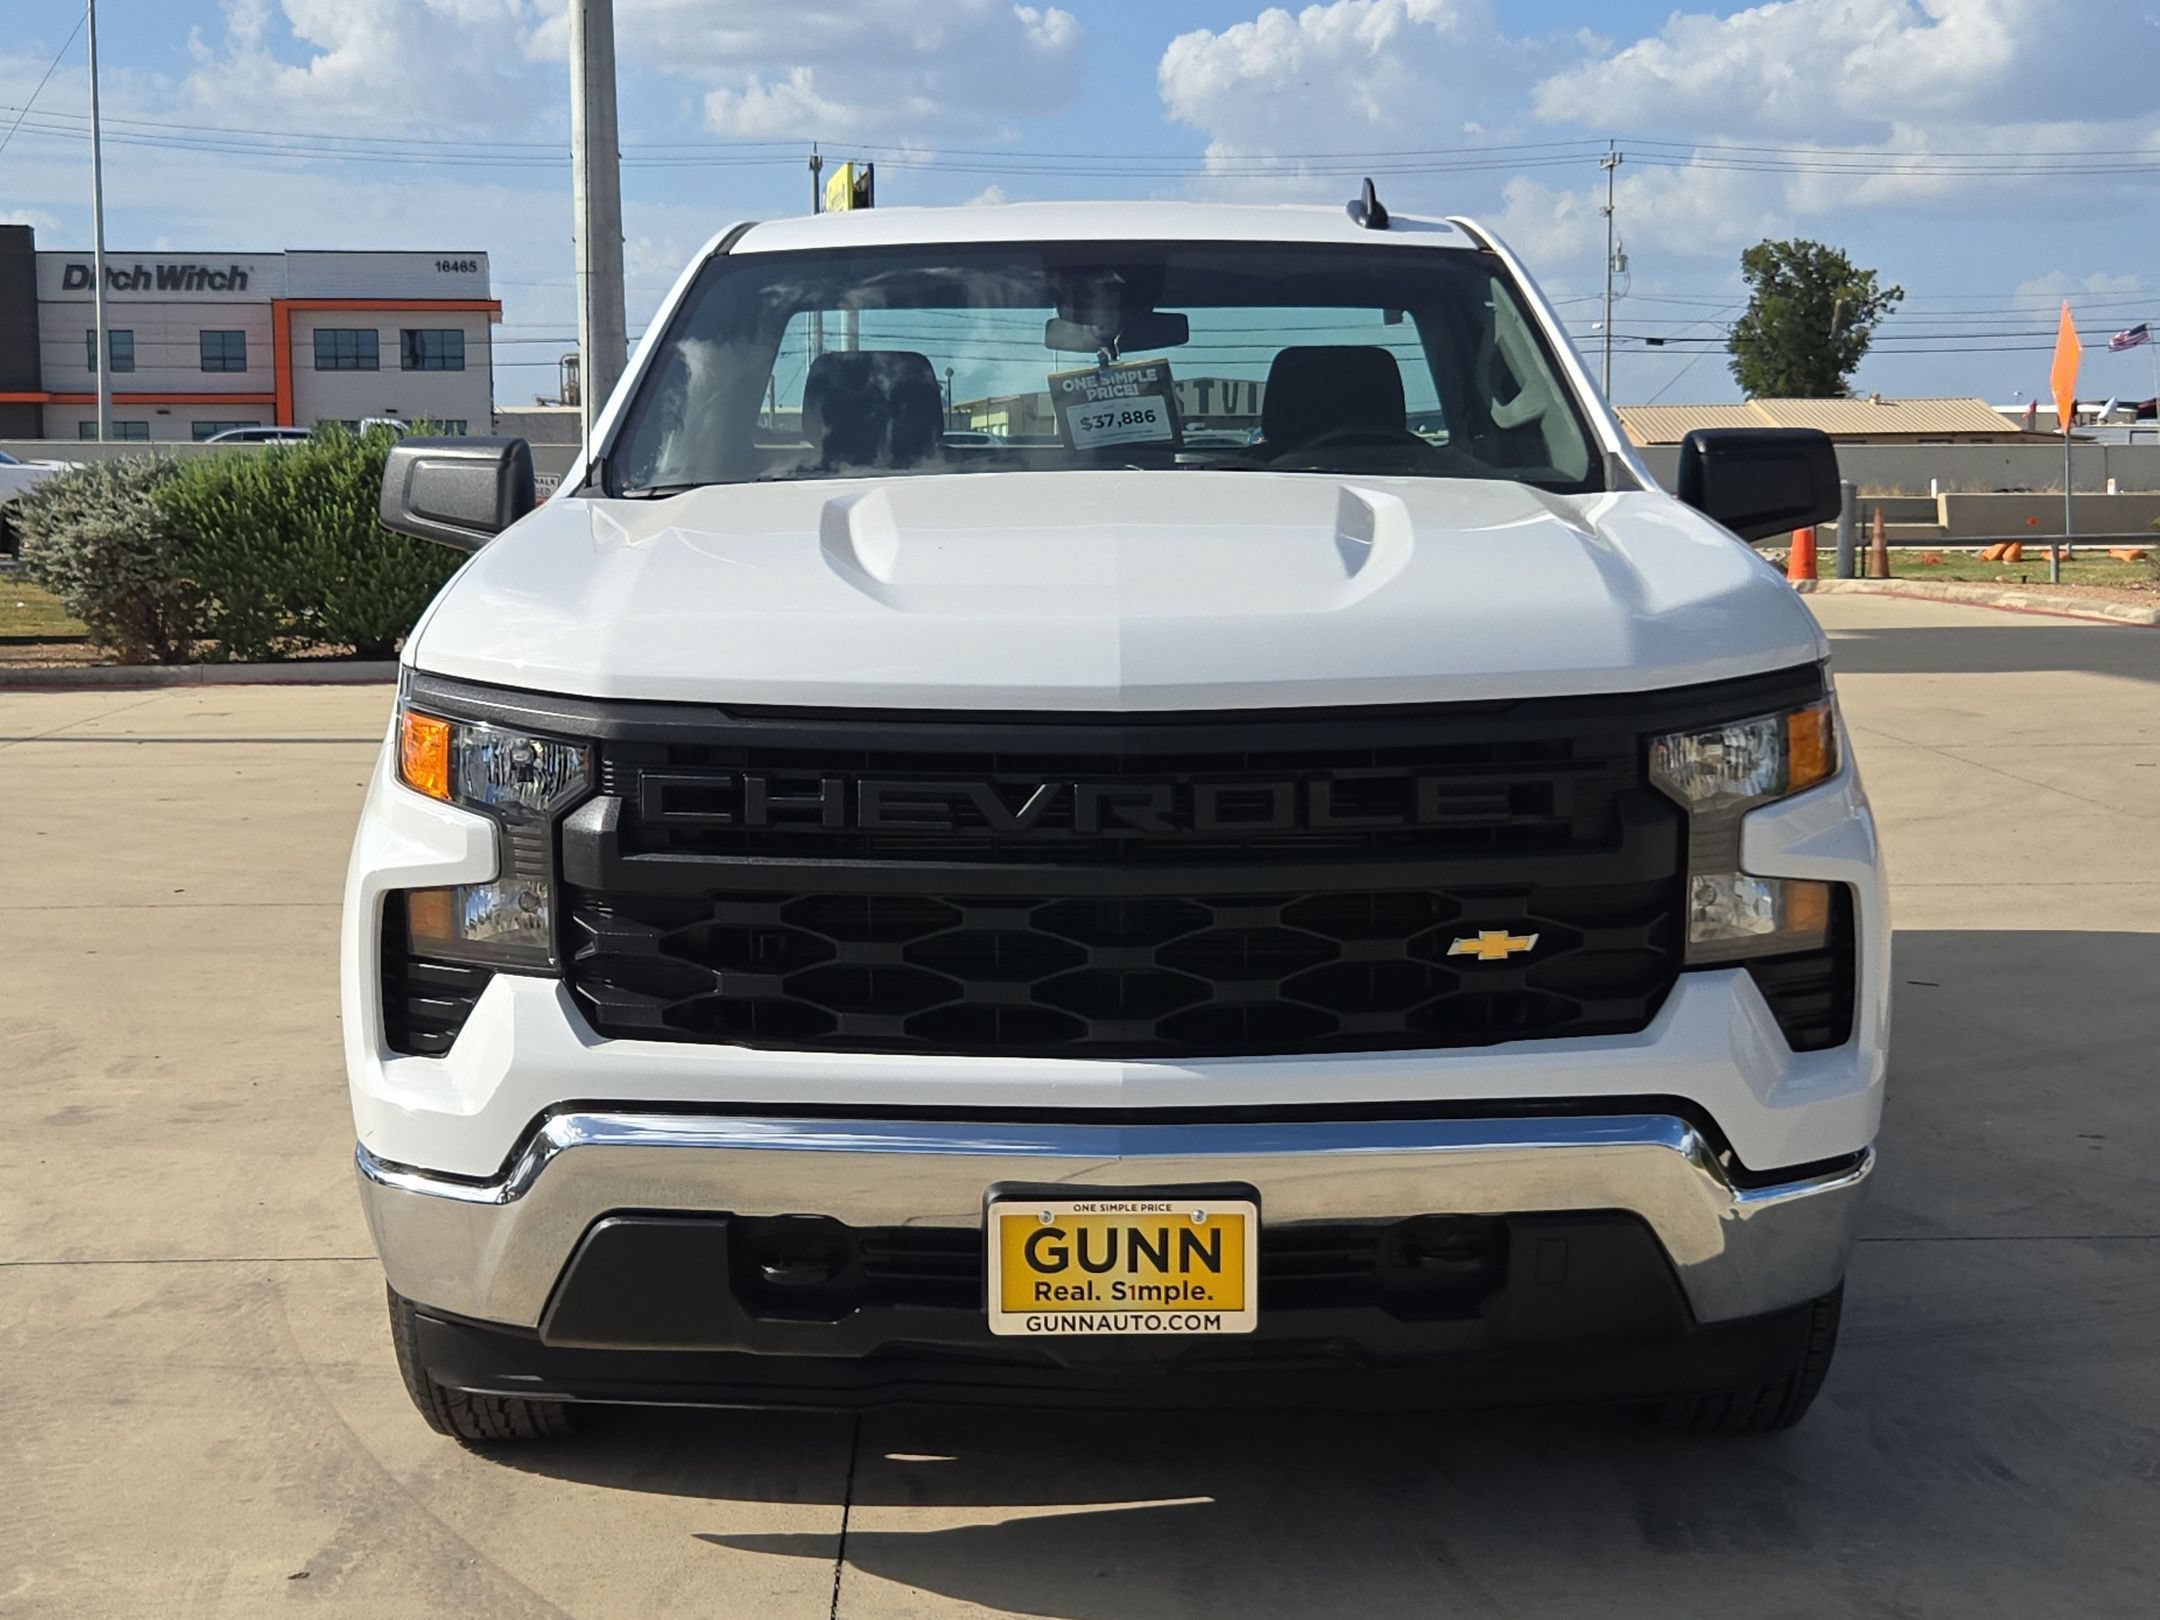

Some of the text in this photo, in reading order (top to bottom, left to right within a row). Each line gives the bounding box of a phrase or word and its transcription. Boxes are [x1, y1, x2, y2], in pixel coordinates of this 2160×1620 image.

[434, 260, 478, 273] 16465
[156, 265, 249, 291] Witch
[1062, 376, 1098, 392] ONE
[1080, 409, 1156, 431] $37,886
[638, 771, 1606, 833] CHEVROLET
[1073, 1204, 1097, 1212] ONE
[1140, 1203, 1172, 1212] PRICE
[1024, 1227, 1221, 1274] GUNN
[1034, 1280, 1101, 1301] Real.
[1026, 1314, 1221, 1333] GUNNAUTO.COM
